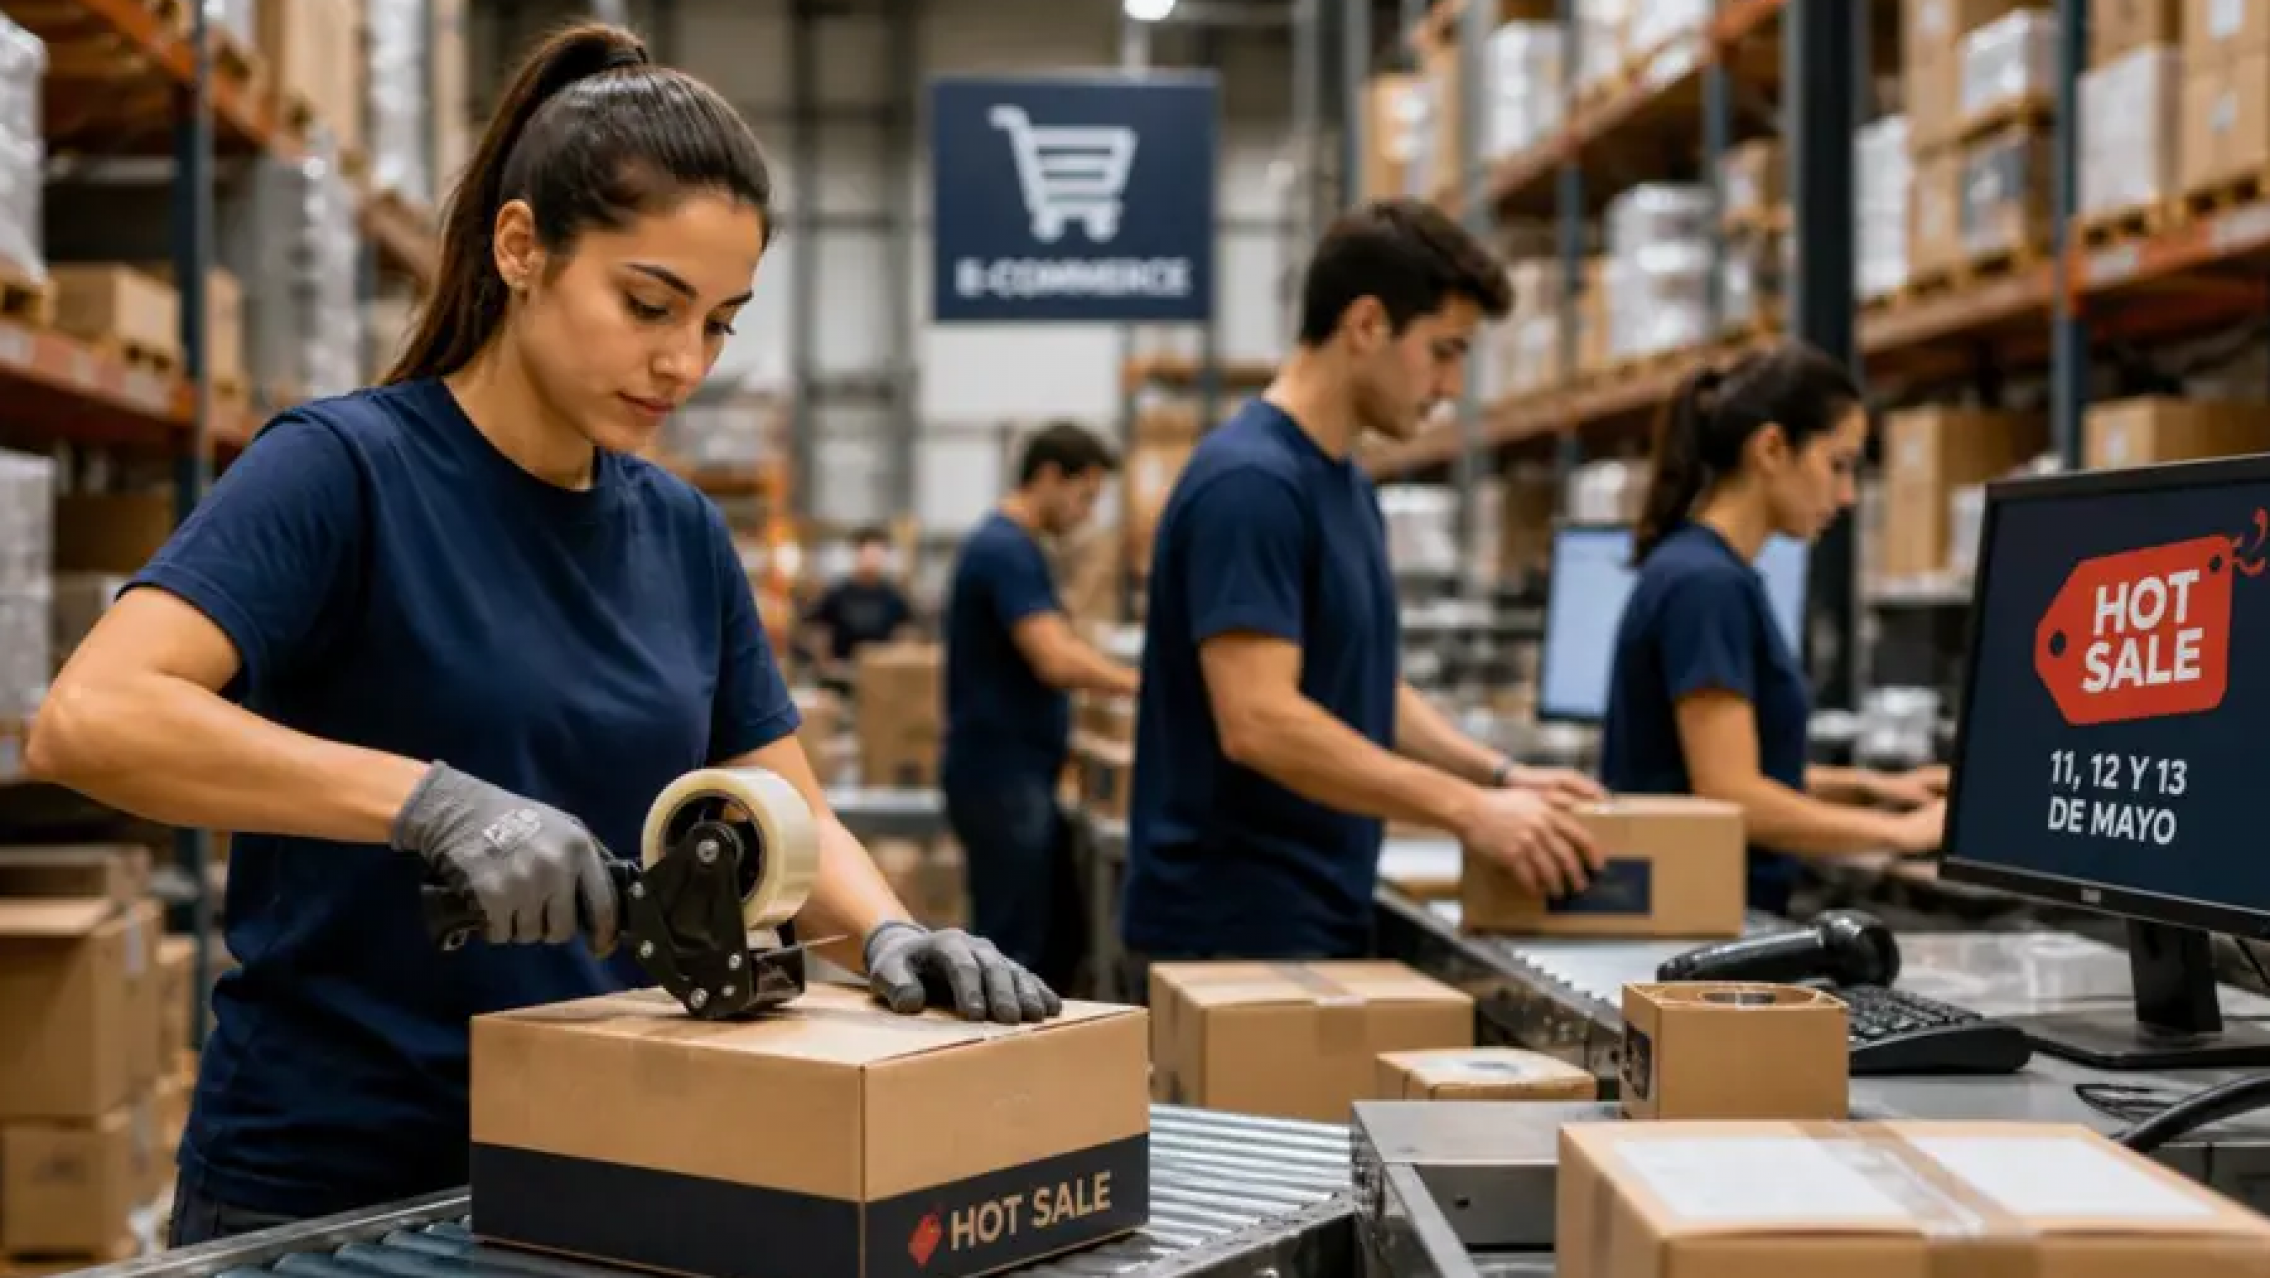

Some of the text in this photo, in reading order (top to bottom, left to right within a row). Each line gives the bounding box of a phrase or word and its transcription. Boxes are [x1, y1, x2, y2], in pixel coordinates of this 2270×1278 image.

[2094, 569, 2200, 636] HOT
[2081, 628, 2204, 693] SALE
[2051, 750, 2188, 795] 11, 12 Y 13
[2048, 796, 2177, 845] DE MAYO
[951, 1170, 1112, 1251] HOT SALE
